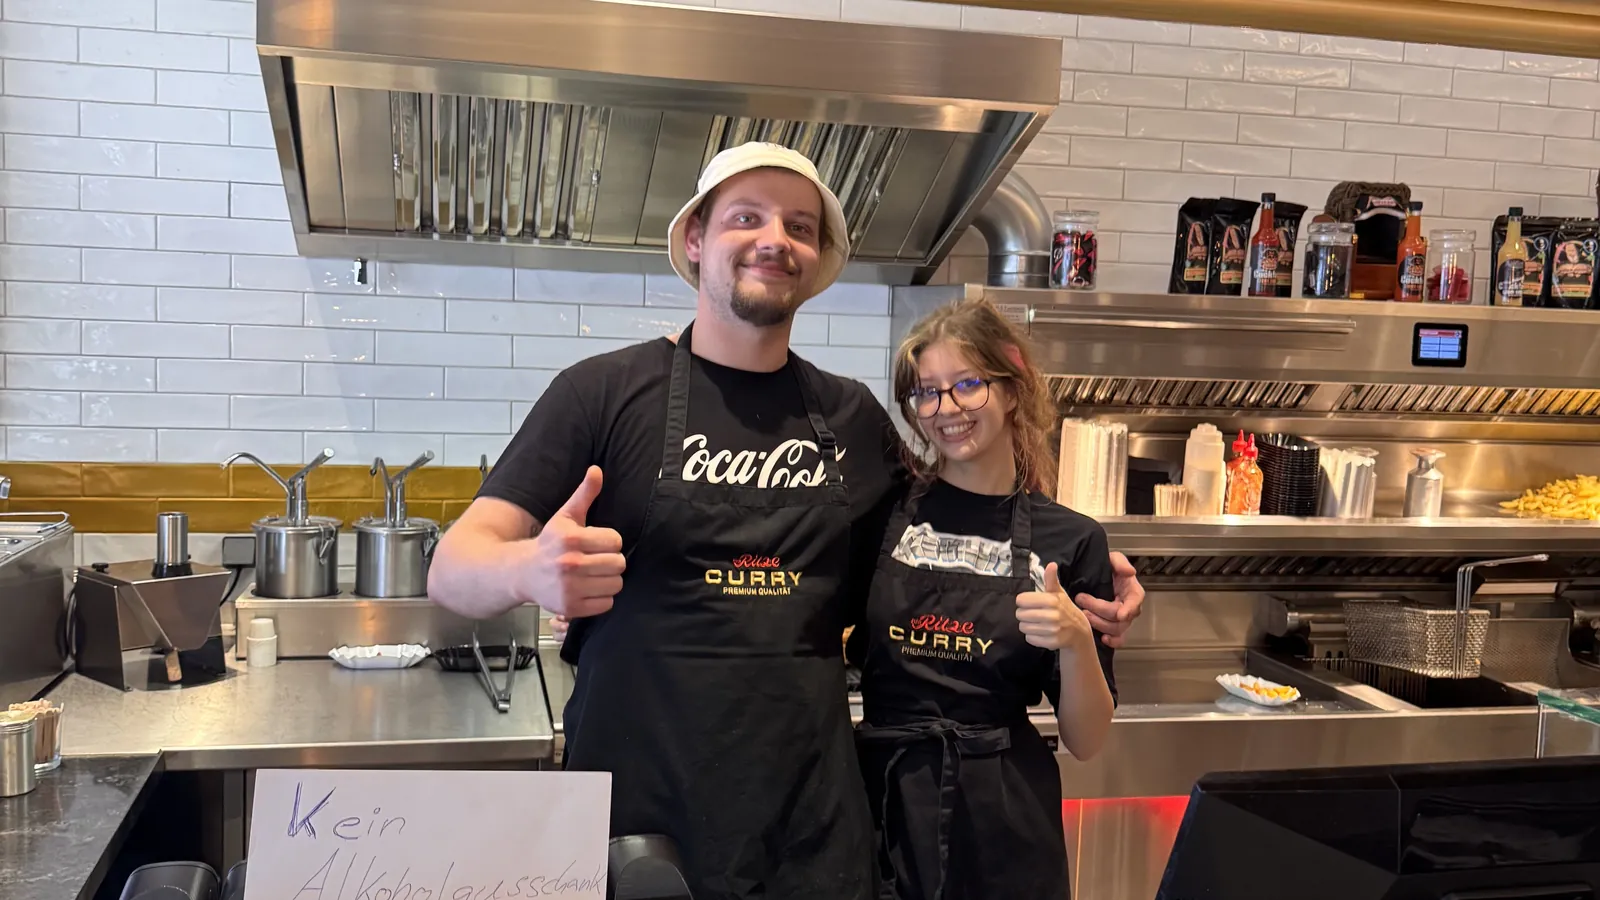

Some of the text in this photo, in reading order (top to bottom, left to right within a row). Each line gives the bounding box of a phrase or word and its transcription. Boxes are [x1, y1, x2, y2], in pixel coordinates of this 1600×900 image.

[705, 569, 802, 586] CURRY
[723, 586, 791, 595] PREMIUM QUALITÄT
[889, 625, 993, 655] CURRY
[901, 645, 937, 658] PREMIUM
[287, 781, 406, 840] Kein
